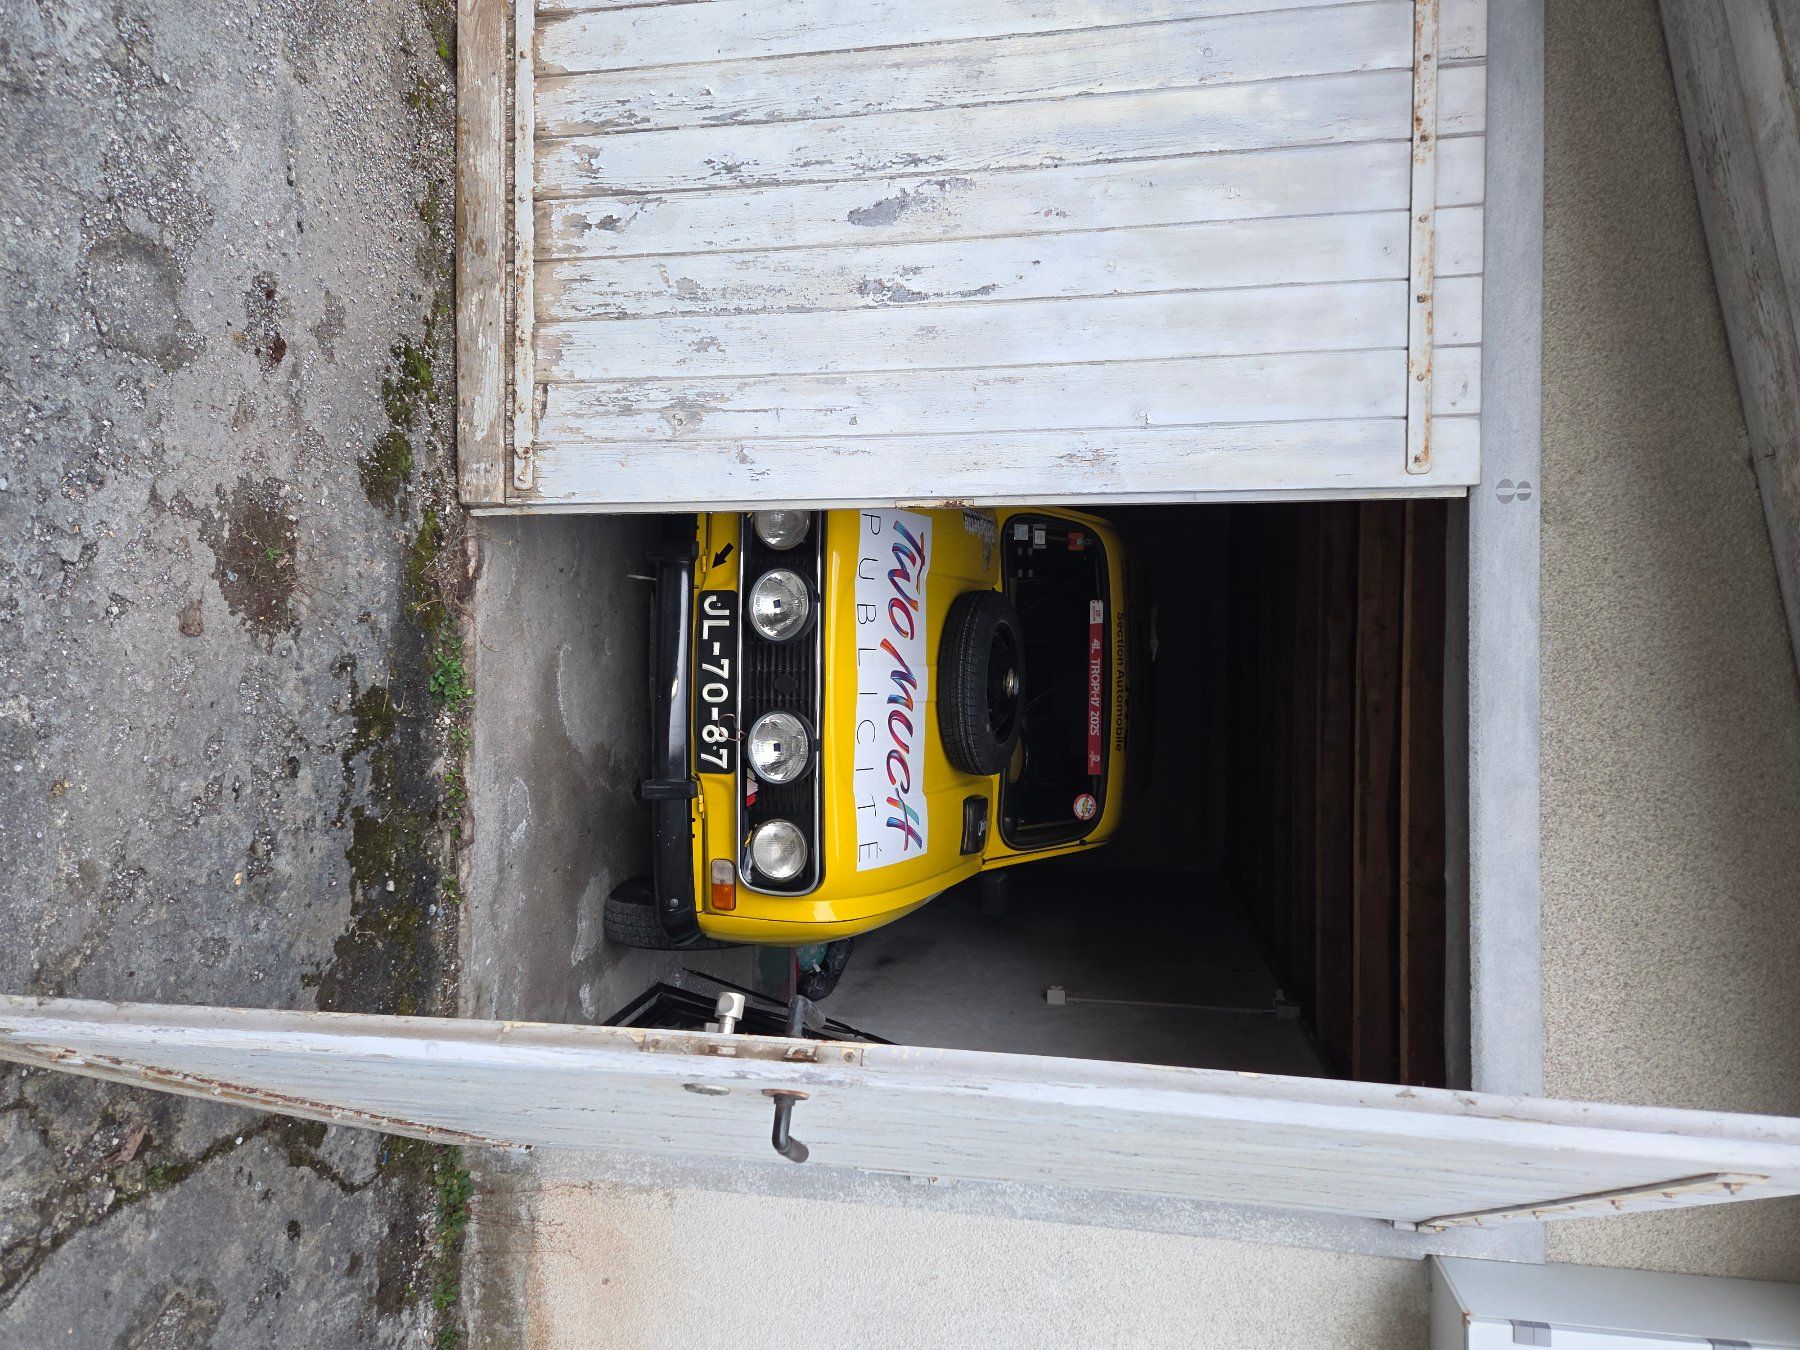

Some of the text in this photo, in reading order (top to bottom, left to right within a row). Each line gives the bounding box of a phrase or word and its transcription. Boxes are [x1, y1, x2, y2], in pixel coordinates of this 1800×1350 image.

[700, 595, 730, 770] JL-70-87
[855, 512, 884, 863] PUBLICITÉ
[880, 520, 926, 851] TWO MUCH
[1090, 639, 1100, 736] 4L TROPHY 2025
[1115, 612, 1125, 752] Section Automobile
